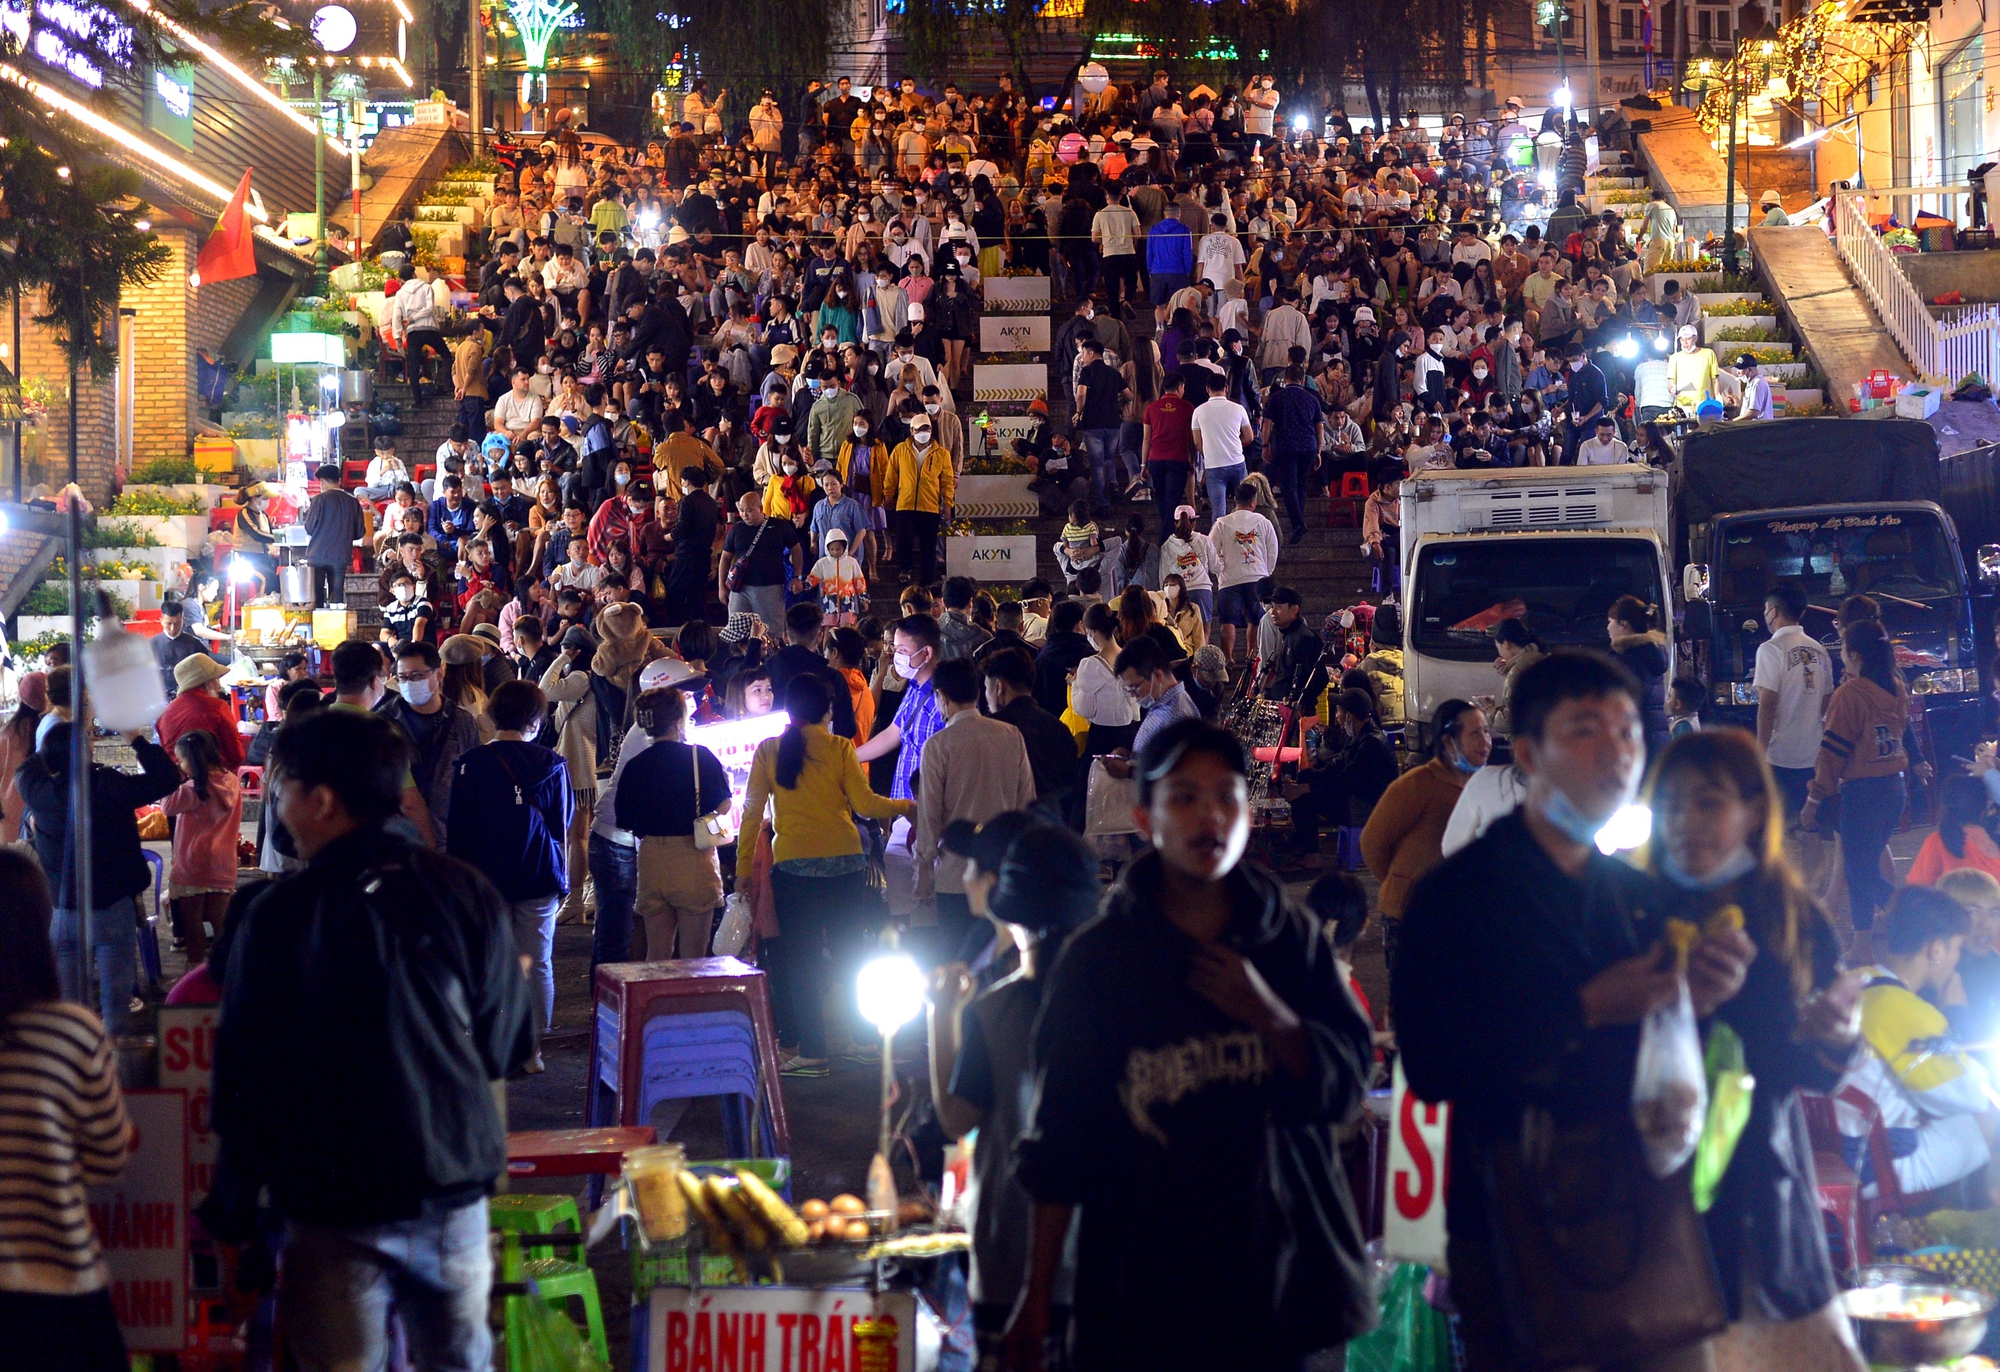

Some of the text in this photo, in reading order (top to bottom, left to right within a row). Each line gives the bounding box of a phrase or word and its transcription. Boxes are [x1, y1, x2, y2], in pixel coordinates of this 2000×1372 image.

[1000, 327, 1031, 335] AKYN
[972, 549, 1011, 560] AKYN
[164, 1016, 217, 1072] SÚ
[112, 1280, 174, 1328] ANH
[665, 1296, 767, 1372] BÁNH
